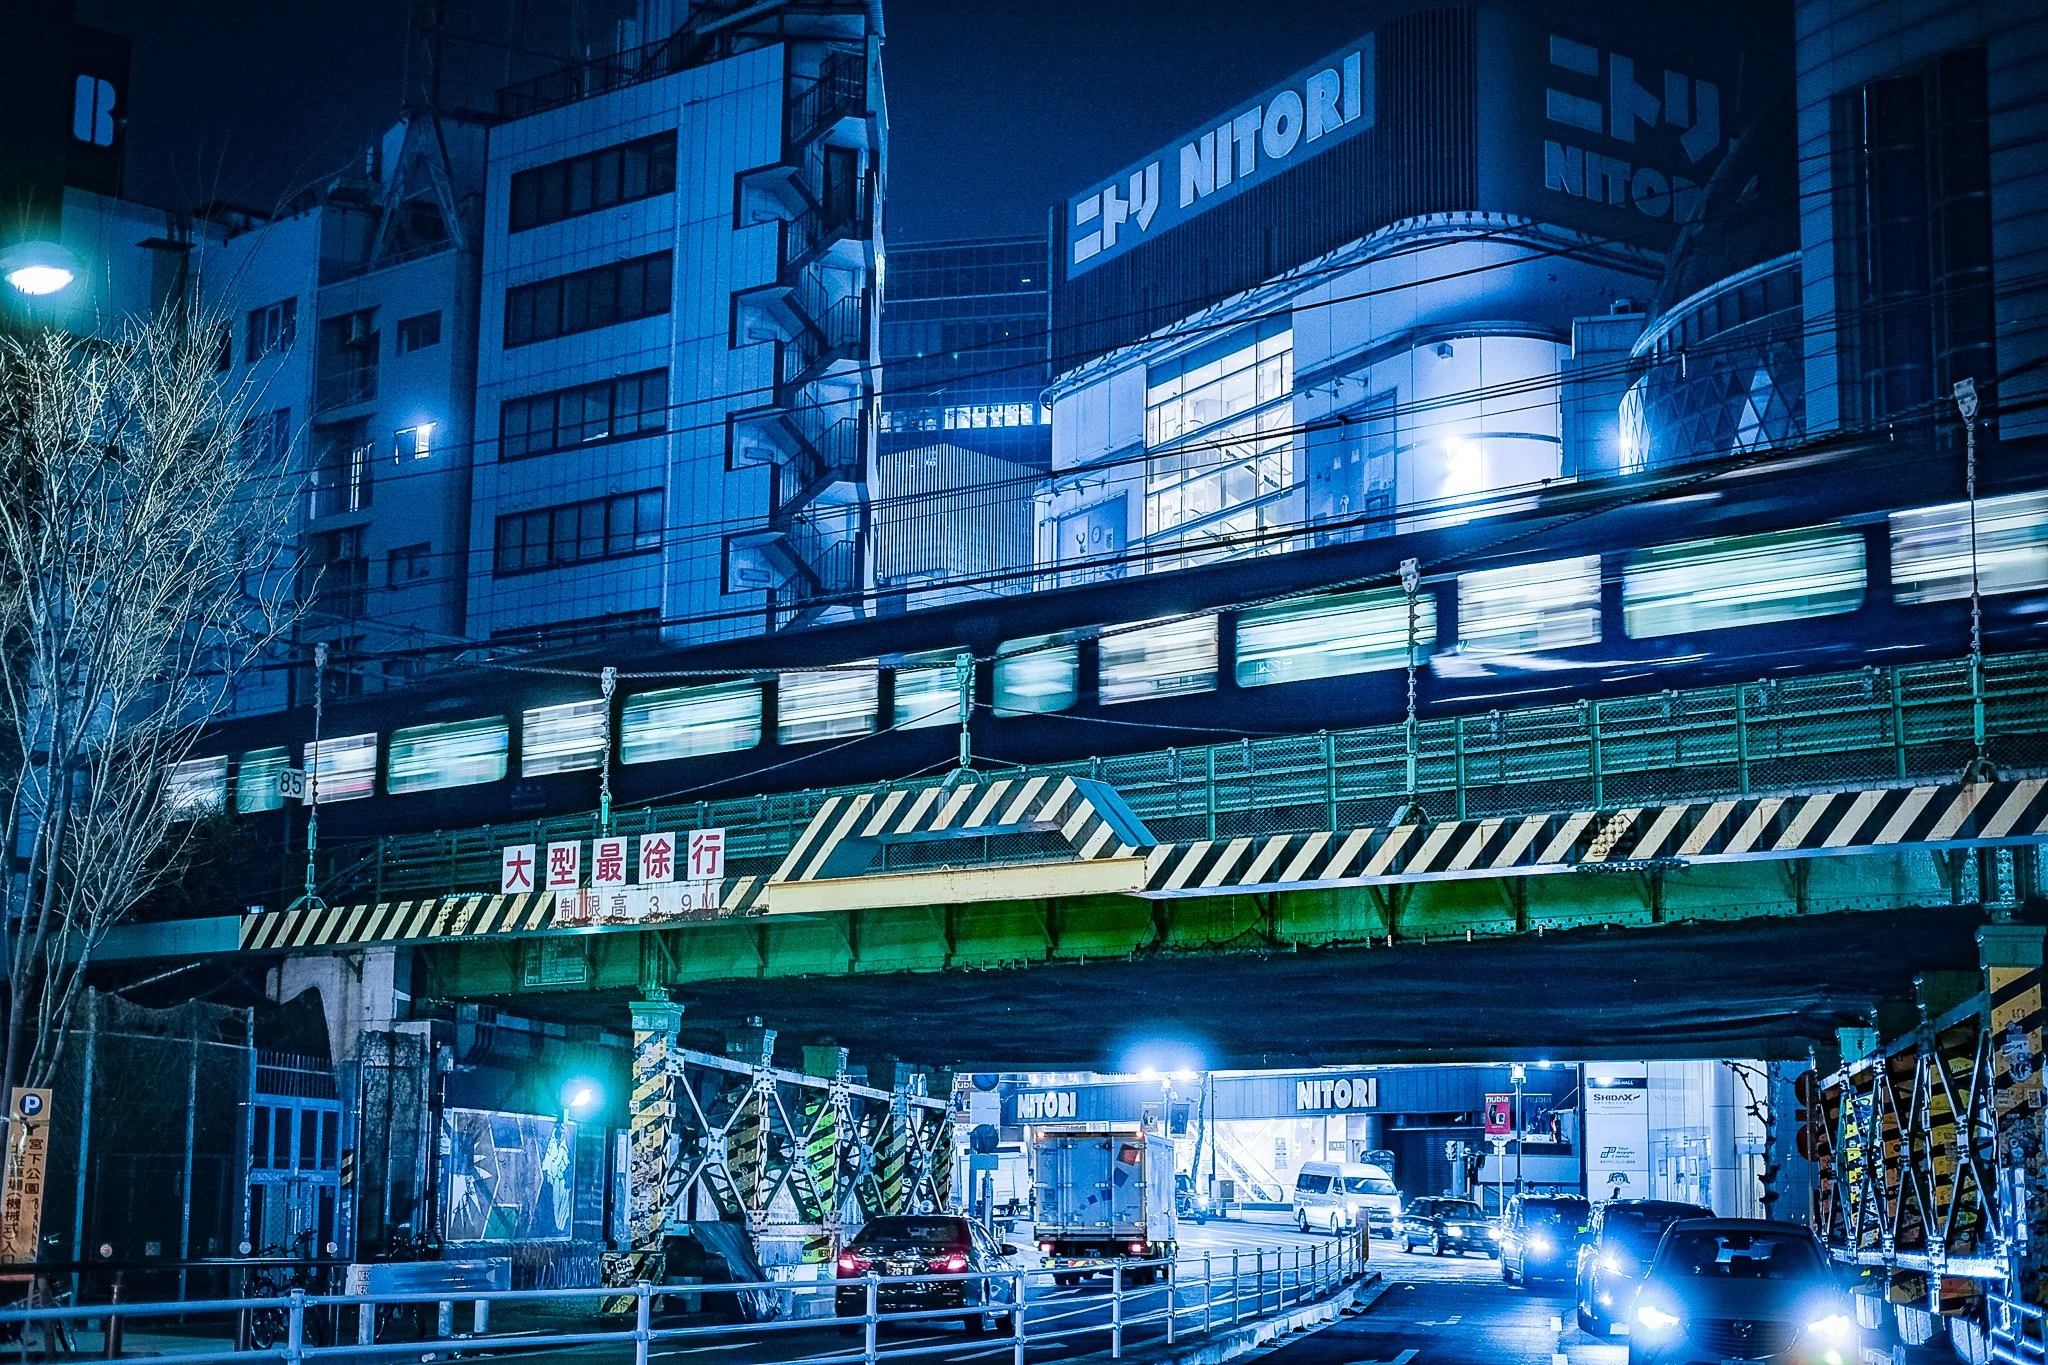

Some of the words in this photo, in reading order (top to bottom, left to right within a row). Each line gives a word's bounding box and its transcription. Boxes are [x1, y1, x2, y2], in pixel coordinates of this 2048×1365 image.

[1547, 34, 1720, 164] ニトリ
[1074, 161, 1159, 264] ニトリ
[1180, 51, 1361, 208] NITORI
[1544, 140, 1703, 224] NITOR
[280, 771, 303, 795] 85
[505, 834, 721, 889] 大型最徐行
[24, 1096, 40, 1113] P
[1017, 1091, 1077, 1118] NITORI
[1296, 1077, 1377, 1110] NITORI
[25, 1138, 43, 1195] 宮下公園
